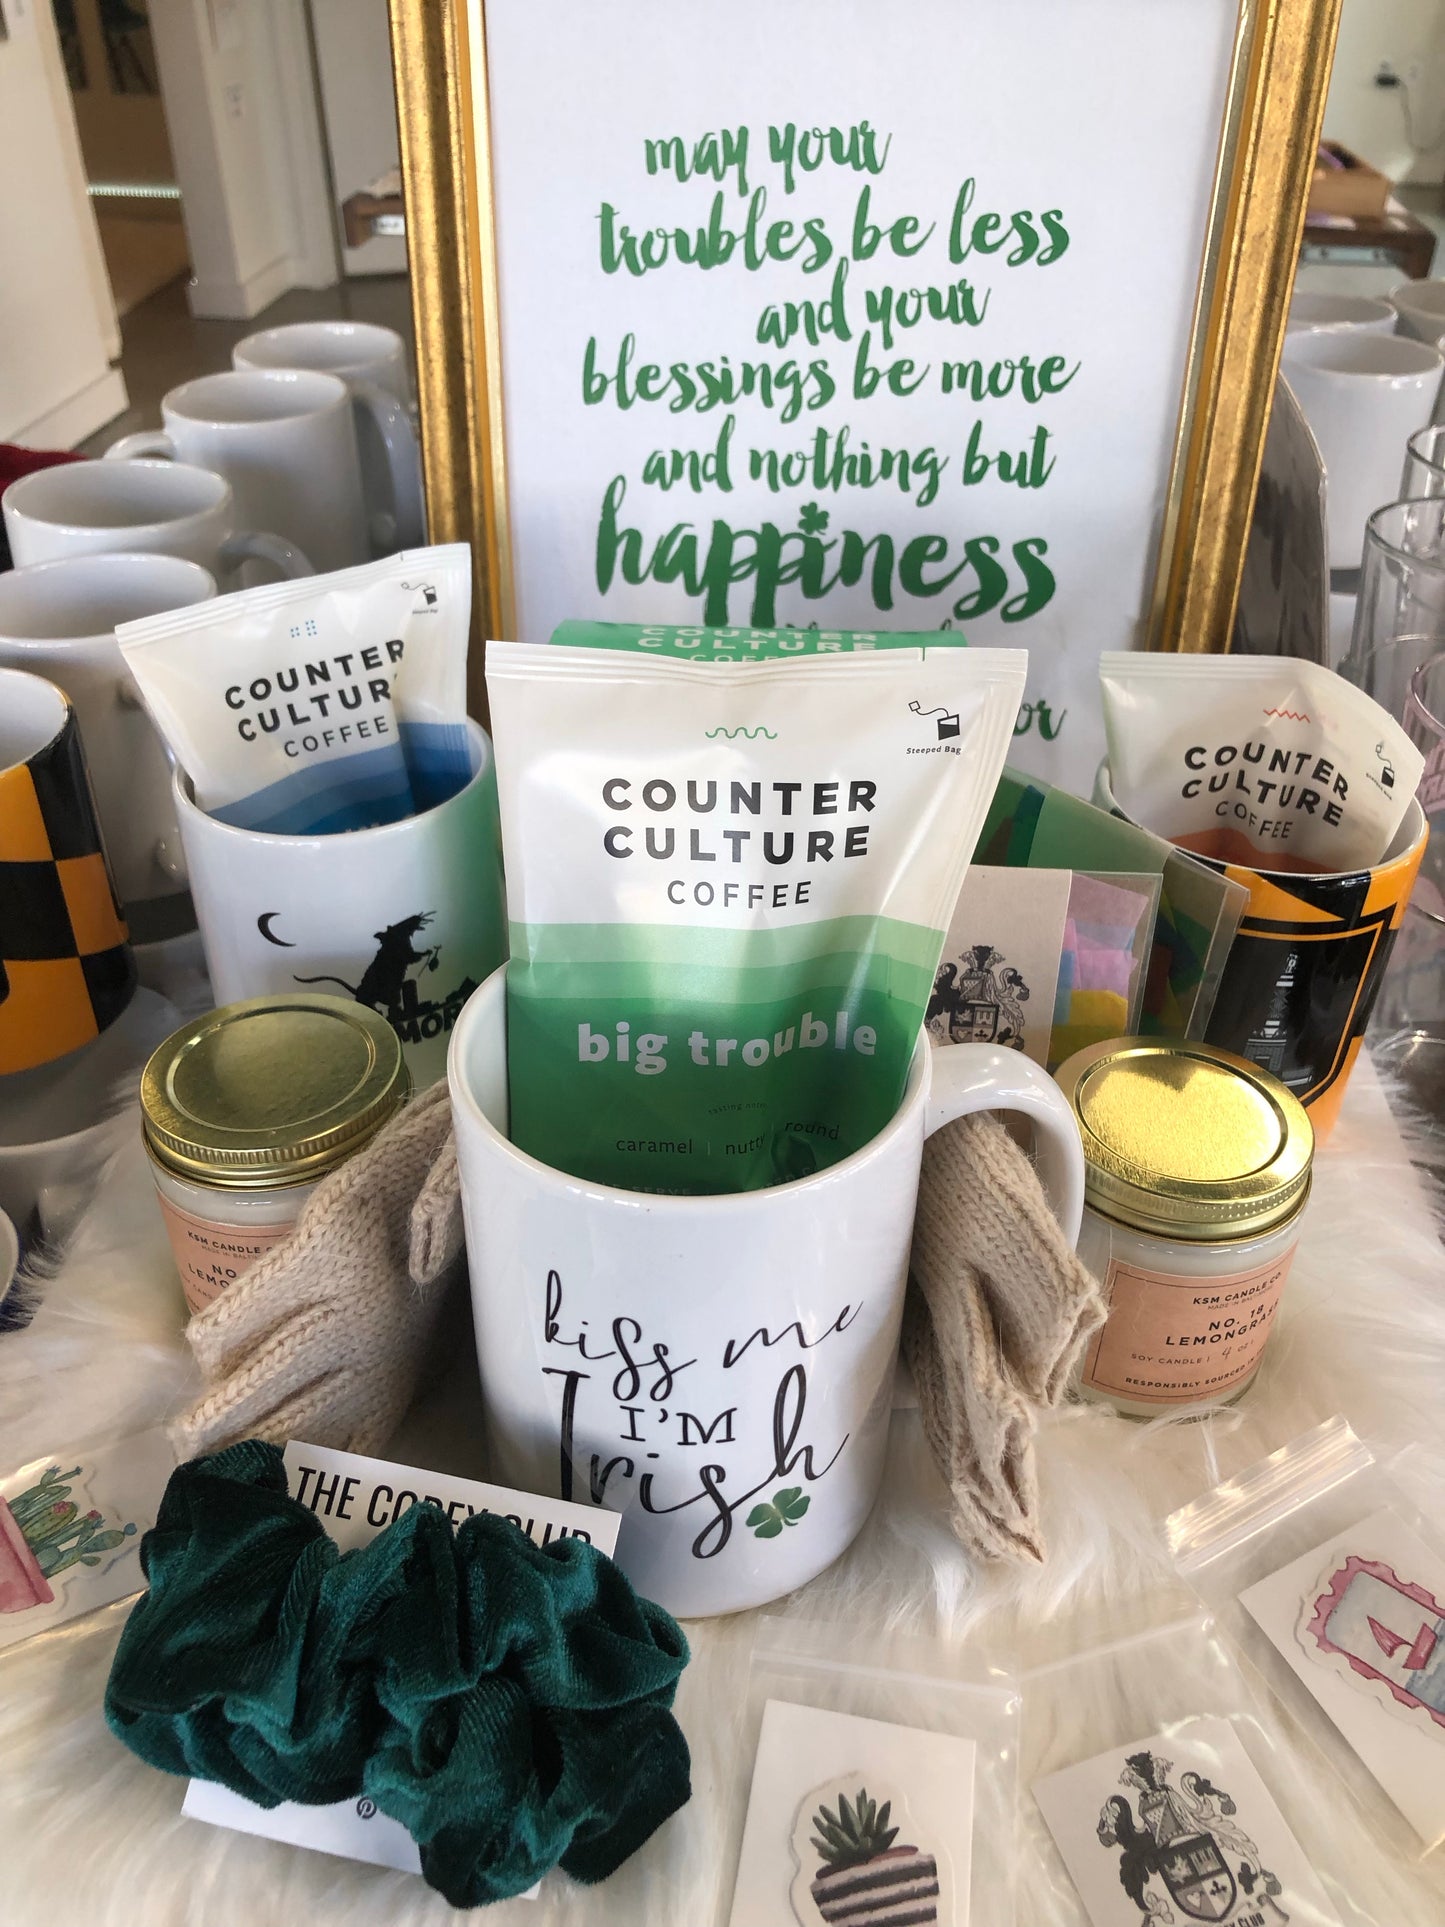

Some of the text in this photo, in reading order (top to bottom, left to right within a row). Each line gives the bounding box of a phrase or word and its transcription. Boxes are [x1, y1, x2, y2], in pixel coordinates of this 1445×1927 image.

[645, 120, 892, 197] may your
[595, 178, 1070, 276] troubles be less
[757, 256, 991, 350] and your
[582, 330, 1082, 424] blessings be more
[643, 415, 1057, 507] and nothing but
[595, 475, 1056, 628] happiness
[637, 637, 876, 652] CULTURE
[641, 627, 877, 642] COUNTER
[225, 639, 404, 709] COUNTER
[238, 678, 400, 741] CULTUR
[284, 716, 389, 757] COFFEE
[905, 745, 962, 756] Steeped Bag
[1184, 742, 1349, 802] COUNTER
[602, 778, 878, 816] COUNTER
[1182, 770, 1343, 827] CULTURE
[1215, 801, 1294, 839] COFFEE
[603, 825, 870, 865] CULTURE
[667, 880, 813, 909] COFFEE
[578, 1011, 877, 1075] big trouble
[615, 1138, 693, 1155] caramel
[784, 1121, 840, 1141] round
[212, 1241, 261, 1254] CANDLE
[1193, 1296, 1220, 1305] KSM
[1225, 1281, 1268, 1302] CANDLE
[545, 1270, 864, 1401] kiss me
[1208, 1318, 1240, 1331] NO.
[1125, 1377, 1201, 1389] RESPONSIBLY
[1204, 1364, 1246, 1385] SOURCED
[1131, 1353, 1153, 1362] SOY
[1158, 1357, 1202, 1365] CANDLE
[620, 1405, 737, 1446] I'M
[541, 1364, 850, 1559] Irish
[297, 1466, 361, 1520] THE
